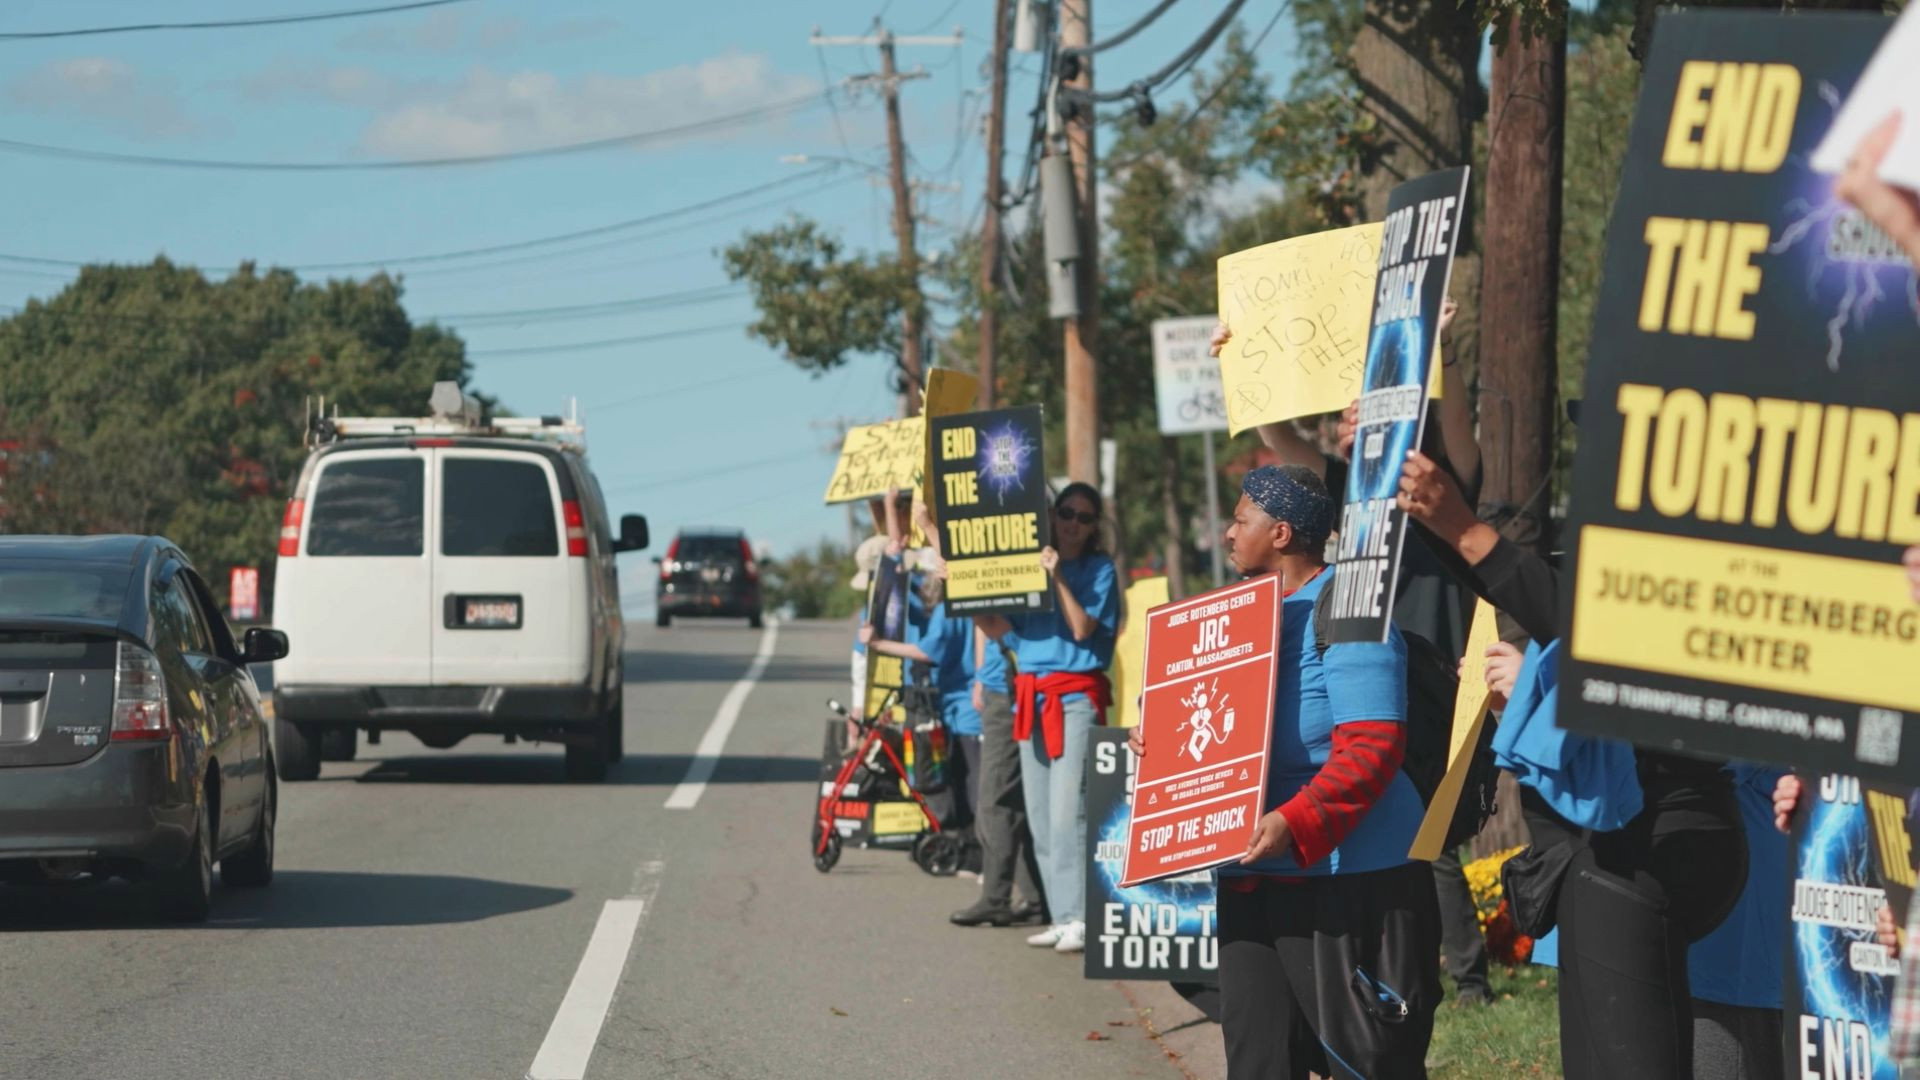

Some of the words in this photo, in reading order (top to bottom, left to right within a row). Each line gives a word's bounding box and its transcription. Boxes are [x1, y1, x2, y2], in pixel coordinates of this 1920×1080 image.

[1661, 60, 1802, 174] END
[1413, 196, 1456, 259] THE
[1375, 259, 1429, 326] SHOCK
[1637, 216, 1771, 341] THE
[1241, 304, 1337, 374] STOP
[1292, 327, 1361, 375] THE
[942, 426, 976, 461] END
[1615, 383, 1920, 545] TORTURE
[943, 470, 979, 507] THE
[947, 512, 1039, 556] TORTURE
[1362, 498, 1397, 557] THE
[952, 570, 979, 581] JUDGE
[982, 564, 1040, 578] ROTENBERG
[976, 580, 1012, 591] CENTER
[1752, 560, 1780, 579] THE
[1167, 611, 1189, 627] JUDGE
[1190, 599, 1230, 621] ROTENBERG
[1230, 591, 1256, 610] CENTER
[1597, 567, 1700, 612] JUDGE
[1712, 583, 1919, 643] ROTENBERG
[1192, 615, 1230, 655] JRC
[1196, 642, 1254, 668] MASSACHUSETTS
[1684, 626, 1812, 674] CENTER
[1618, 683, 1704, 719] TURNPIKE
[1813, 715, 1846, 743] MA
[1140, 824, 1174, 853] STOP
[1176, 817, 1202, 843] THE
[1203, 805, 1247, 836] SHOCK
[1866, 789, 1918, 889] THE
[1104, 902, 1177, 936] END
[1795, 884, 1829, 919] JUDGE
[1099, 935, 1218, 970] TORTU
[1800, 1015, 1873, 1080] END
